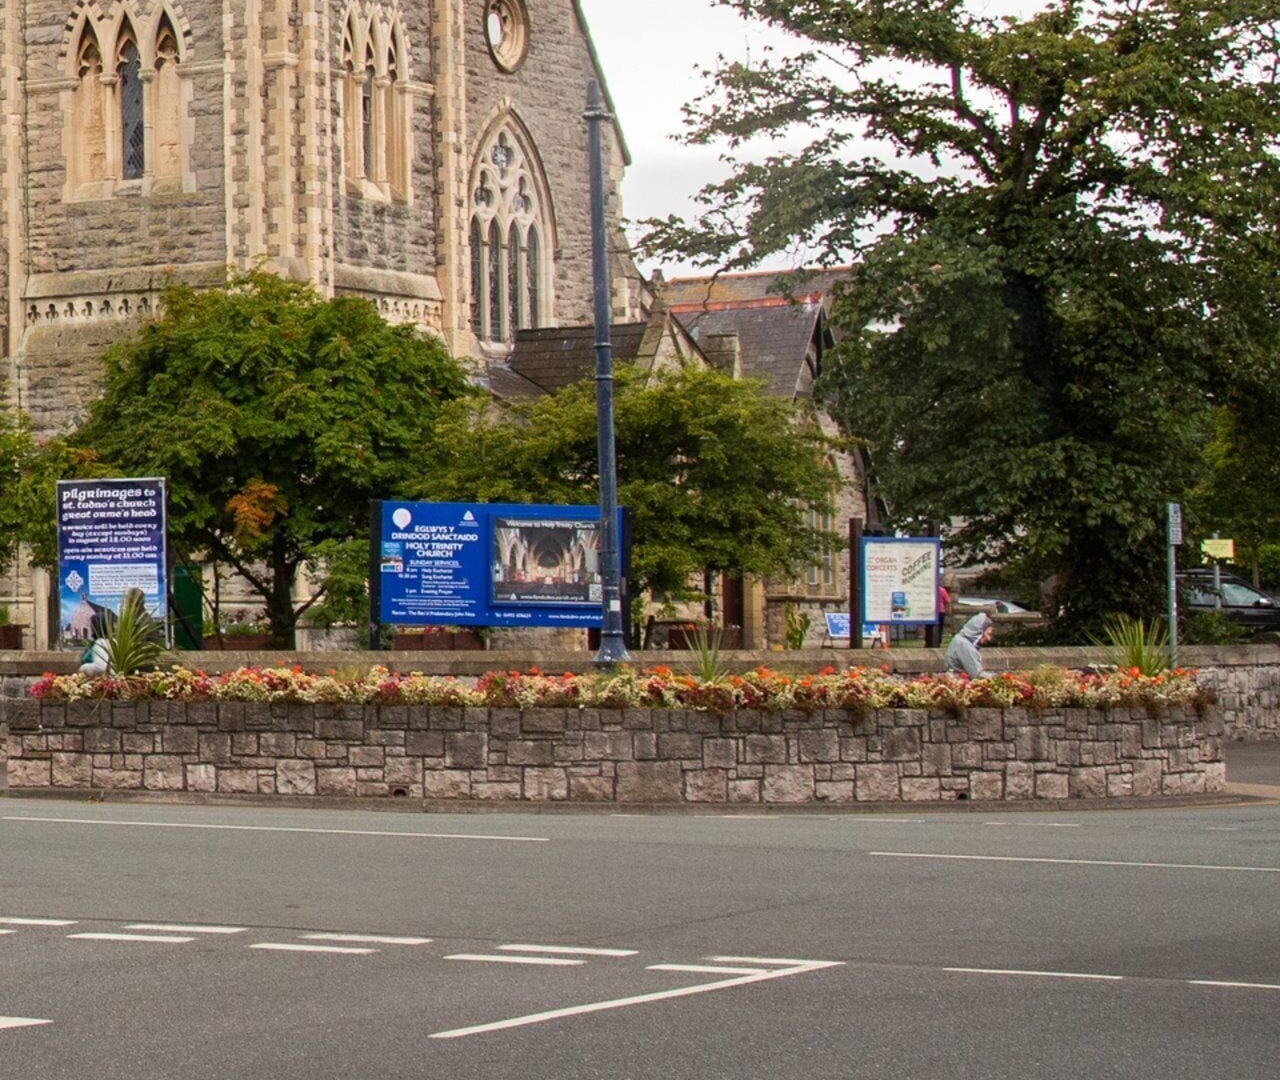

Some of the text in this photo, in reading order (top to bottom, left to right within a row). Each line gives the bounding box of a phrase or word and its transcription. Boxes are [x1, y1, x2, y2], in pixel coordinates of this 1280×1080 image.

[62, 488, 156, 501] pilgrimages to
[116, 498, 156, 508] church
[62, 508, 157, 521] great orme's head
[505, 520, 533, 528] Welcome
[541, 520, 556, 529] Holy
[556, 520, 573, 529] Trinity
[574, 521, 595, 529] Church
[391, 532, 478, 541] DRINDOD SANCTAIDD
[405, 542, 429, 550] HOLY
[431, 542, 464, 551] TRINITY
[901, 550, 932, 576] COFFEE
